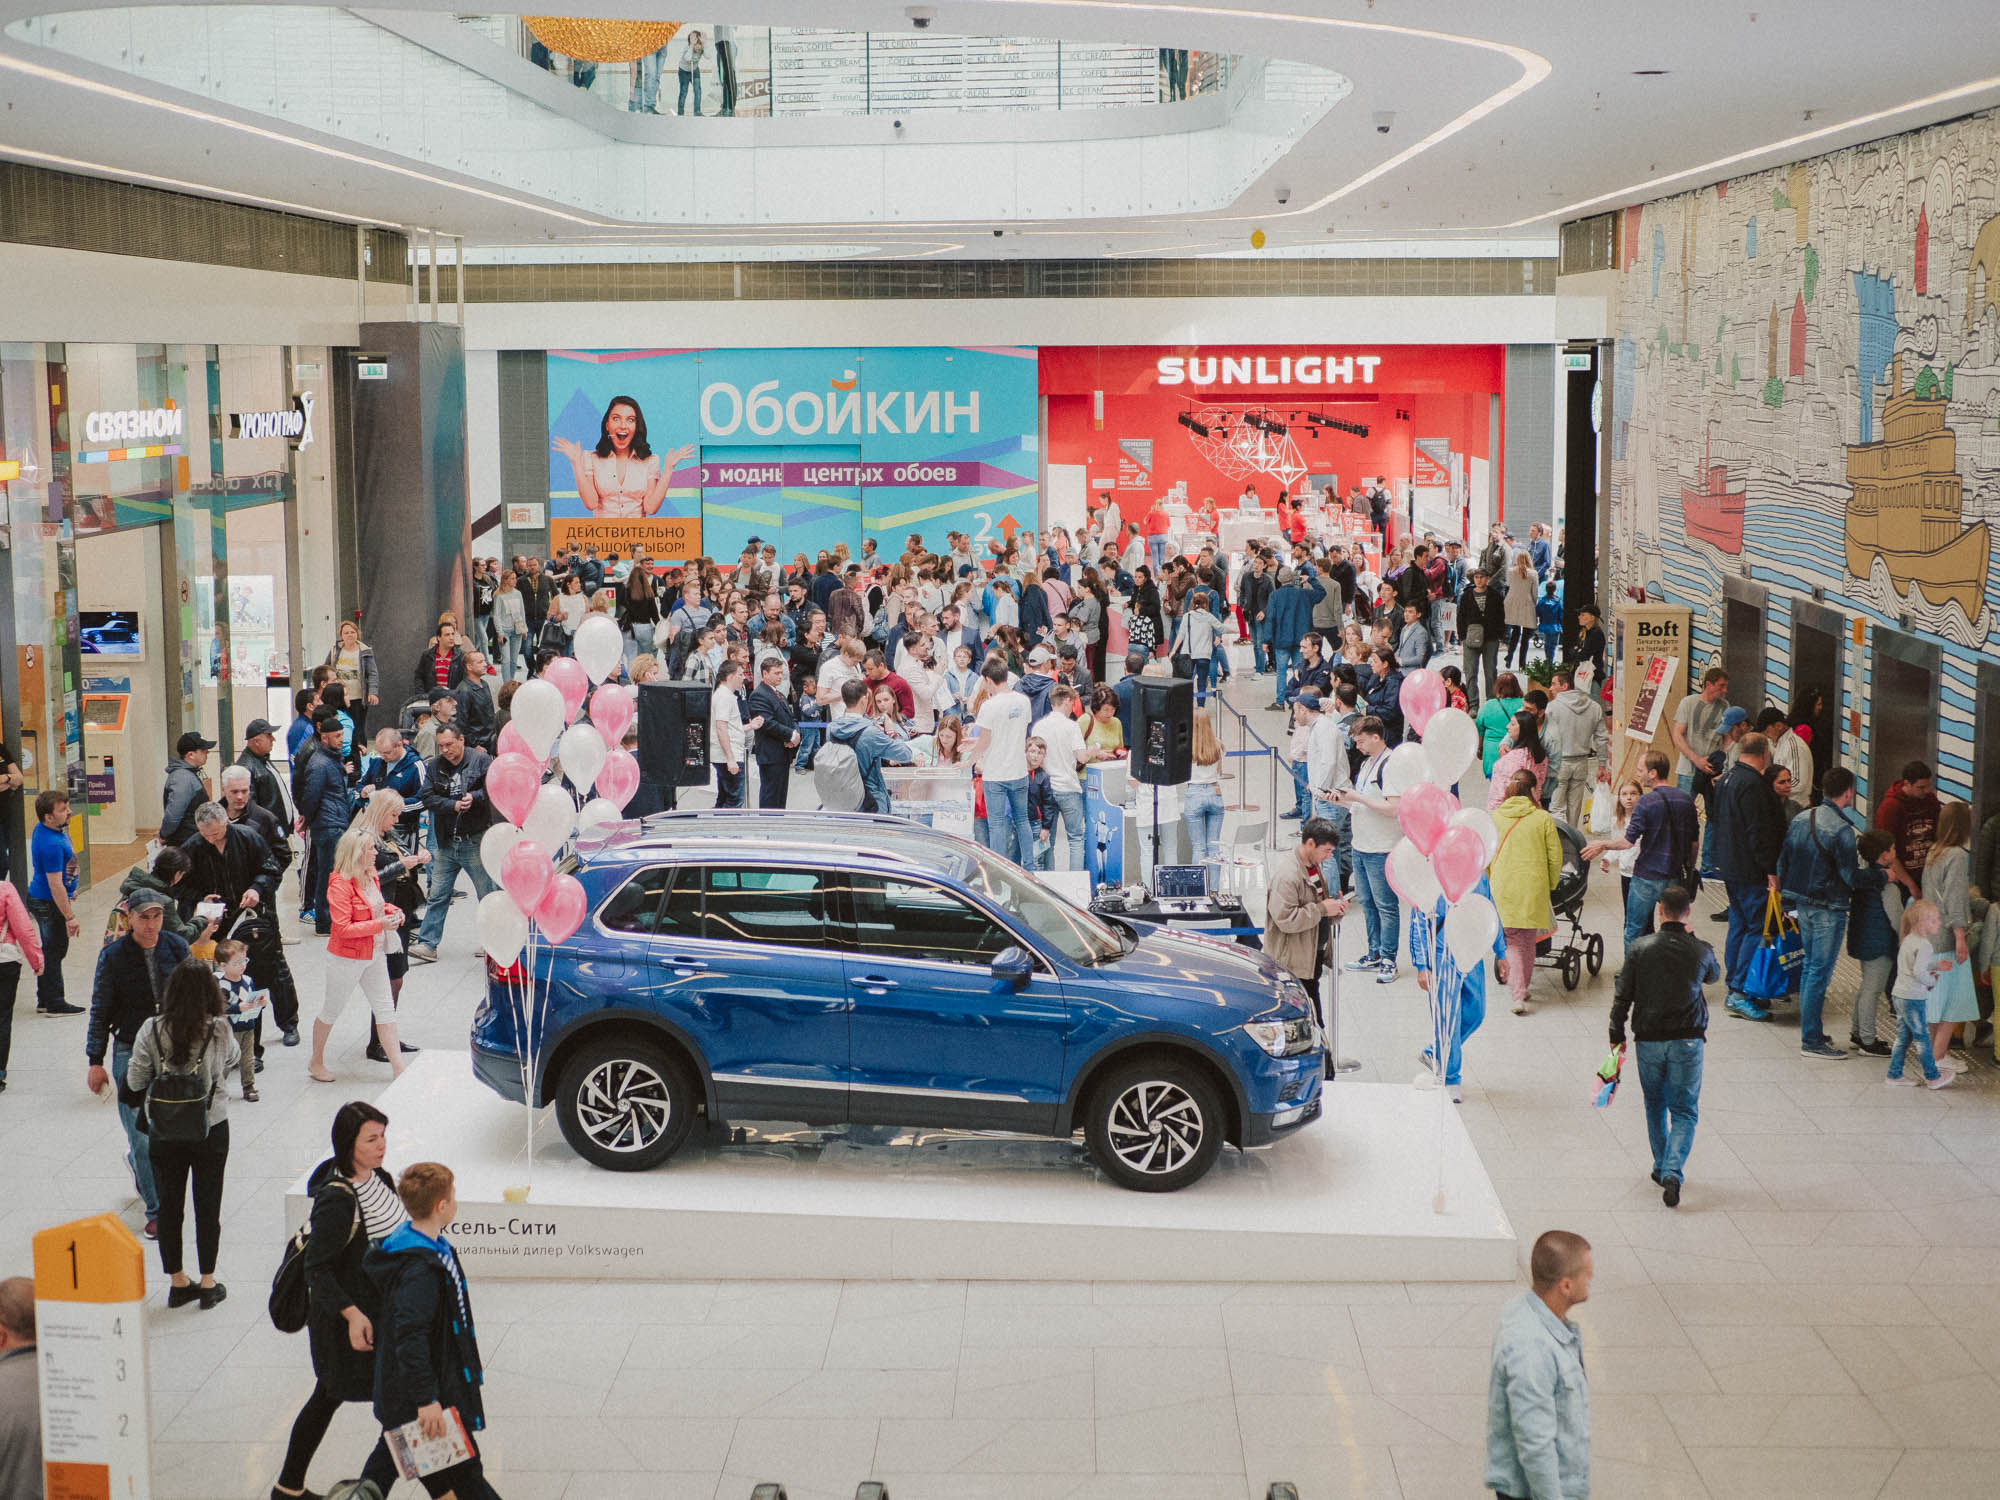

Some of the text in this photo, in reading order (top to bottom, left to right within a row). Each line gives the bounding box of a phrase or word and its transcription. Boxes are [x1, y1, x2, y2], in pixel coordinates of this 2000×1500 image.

[807, 42, 833, 50] COFFEE
[925, 73, 952, 81] CREAM
[1156, 356, 1381, 384] SUNLIGHT
[700, 370, 980, 436] Обойкин
[86, 406, 182, 443] СВЯЗНОЙ
[238, 410, 303, 439] ХРОНОГРАФ
[894, 463, 957, 482] обоев
[566, 525, 685, 539] ДЕЙСТВИТЕЛЬНО
[974, 512, 993, 542] 2
[638, 543, 685, 553] ЫБОР!
[1637, 620, 1679, 637] Boft
[524, 1247, 563, 1258] дилер
[567, 1244, 645, 1259] Volkswagen
[66, 1239, 79, 1290] 1
[116, 1357, 127, 1382] 3
[117, 1412, 129, 1438] 2
